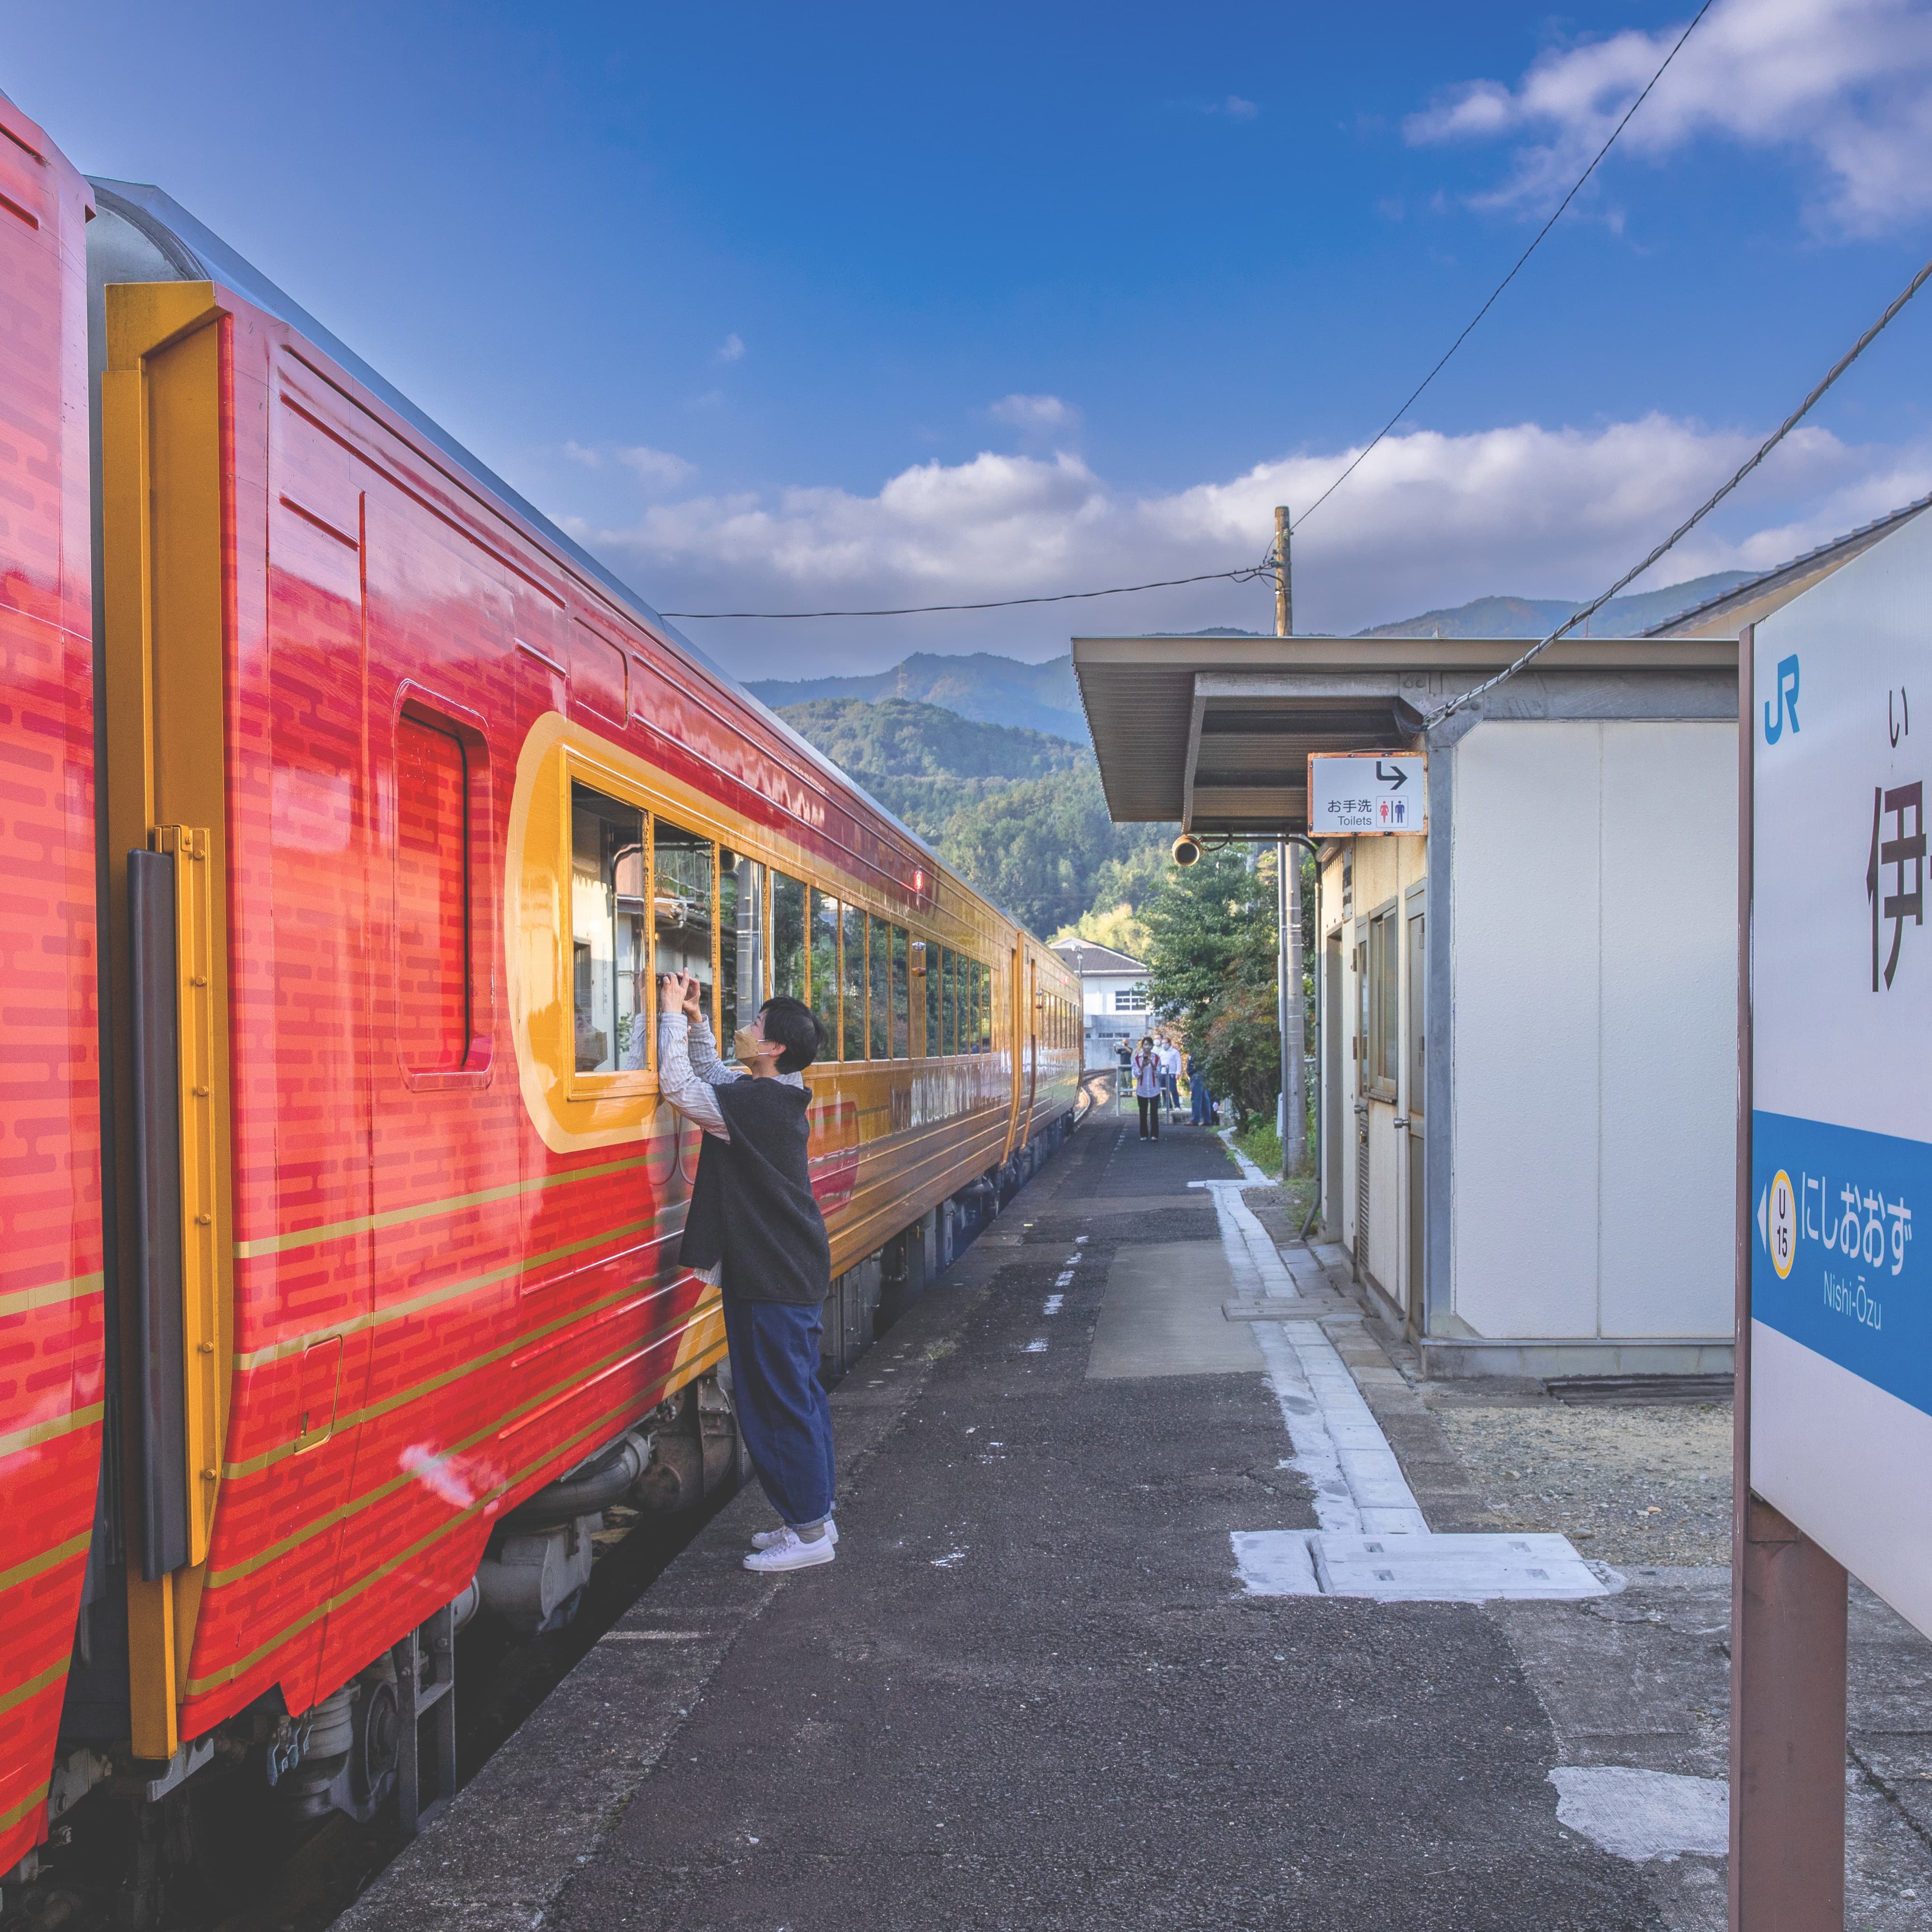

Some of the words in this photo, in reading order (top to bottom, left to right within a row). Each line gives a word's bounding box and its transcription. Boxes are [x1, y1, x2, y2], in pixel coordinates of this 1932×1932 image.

[1764, 653, 1800, 745] JR
[1889, 685, 1908, 748] い
[1327, 799, 1372, 813] お手洗
[1337, 816, 1372, 825] Toilets
[1866, 780, 1932, 993] 伊
[1778, 1188, 1786, 1220] U
[1801, 1171, 1912, 1276] にしおおず
[1776, 1225, 1788, 1258] 15
[1823, 1270, 1881, 1331] Nishi-Ōzu
